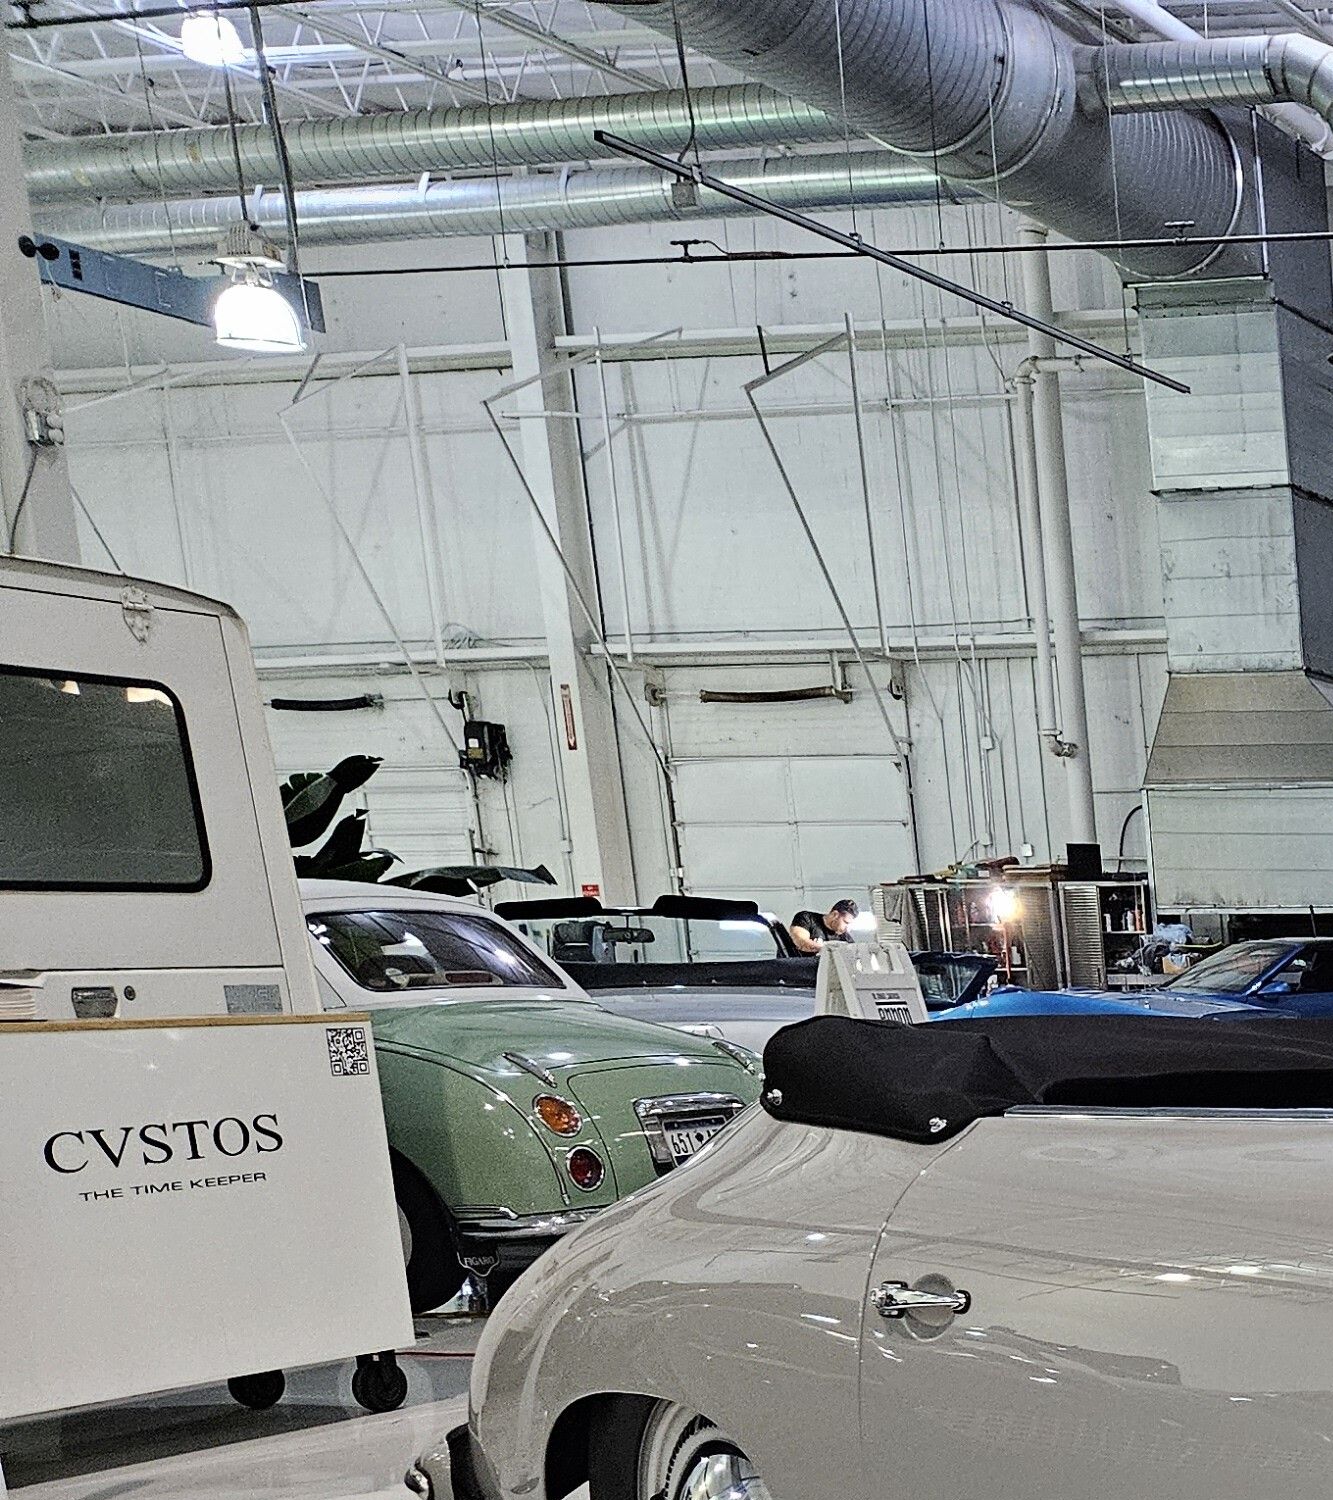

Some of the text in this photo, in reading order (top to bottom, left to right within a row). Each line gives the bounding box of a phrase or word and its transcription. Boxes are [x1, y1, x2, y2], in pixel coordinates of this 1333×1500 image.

[44, 1113, 283, 1174] CVSTOS
[79, 1172, 267, 1202] THE TIME KEEPER
